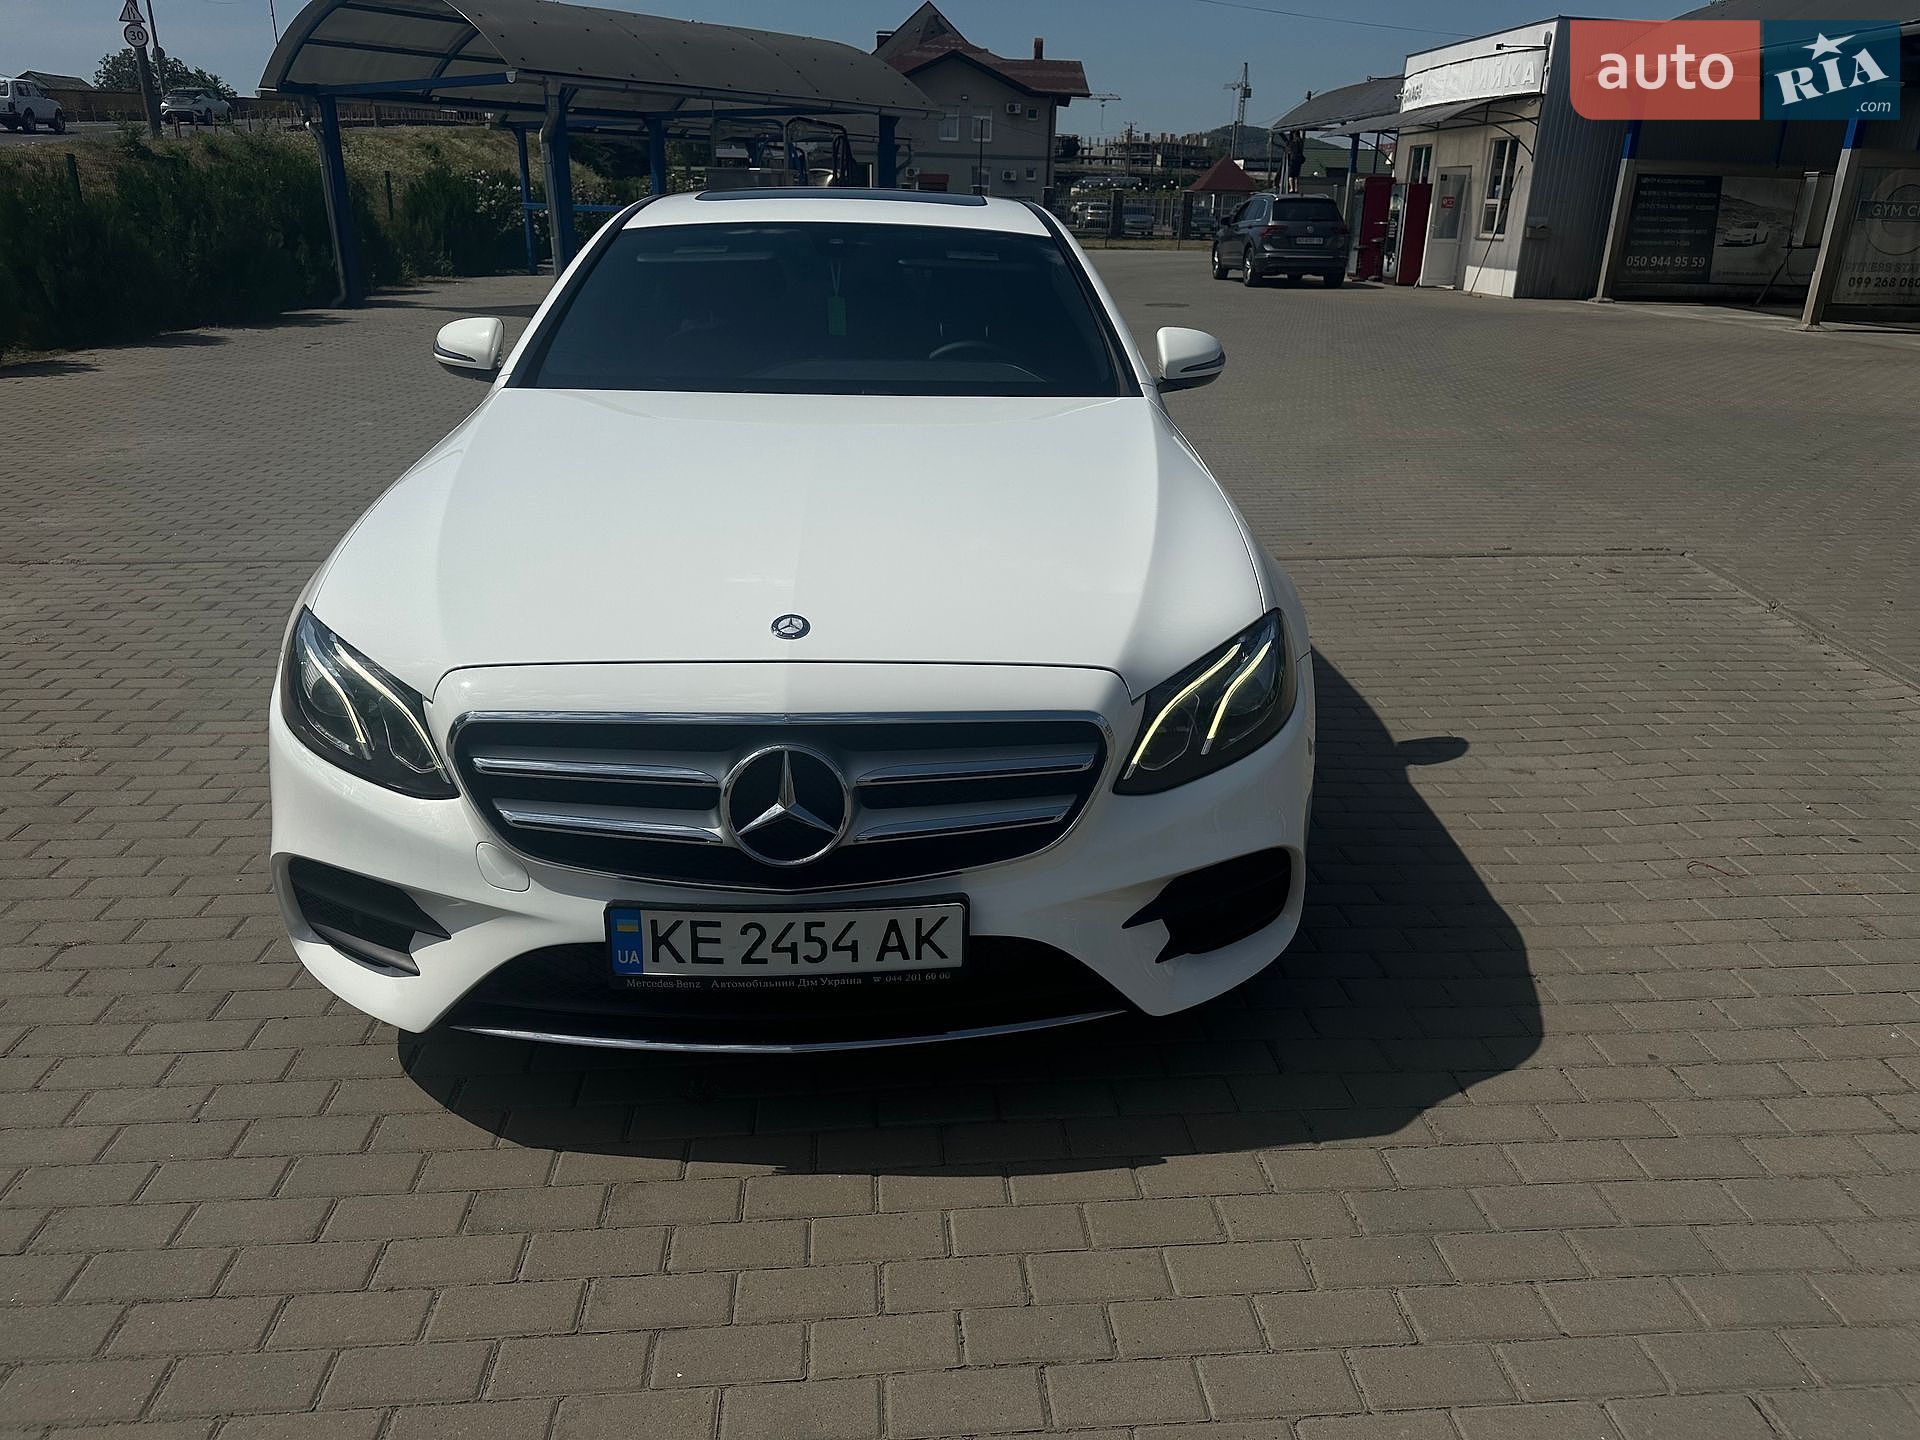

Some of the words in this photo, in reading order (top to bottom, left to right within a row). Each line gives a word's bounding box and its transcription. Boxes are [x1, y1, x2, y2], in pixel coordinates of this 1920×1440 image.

[129, 31, 144, 41] 30
[1871, 203, 1903, 217] GYM
[1625, 255, 1648, 267] 050
[1649, 255, 1671, 268] 944
[1674, 256, 1689, 268] 95
[1690, 256, 1706, 268] 59
[1848, 277, 1872, 288] 099
[1874, 277, 1897, 288] 268
[649, 918, 725, 965] KE
[739, 920, 860, 966] 2454
[875, 915, 950, 962] AK
[617, 949, 641, 965] UA
[626, 978, 702, 989] Mercedes-Benz
[904, 973, 922, 983] 201
